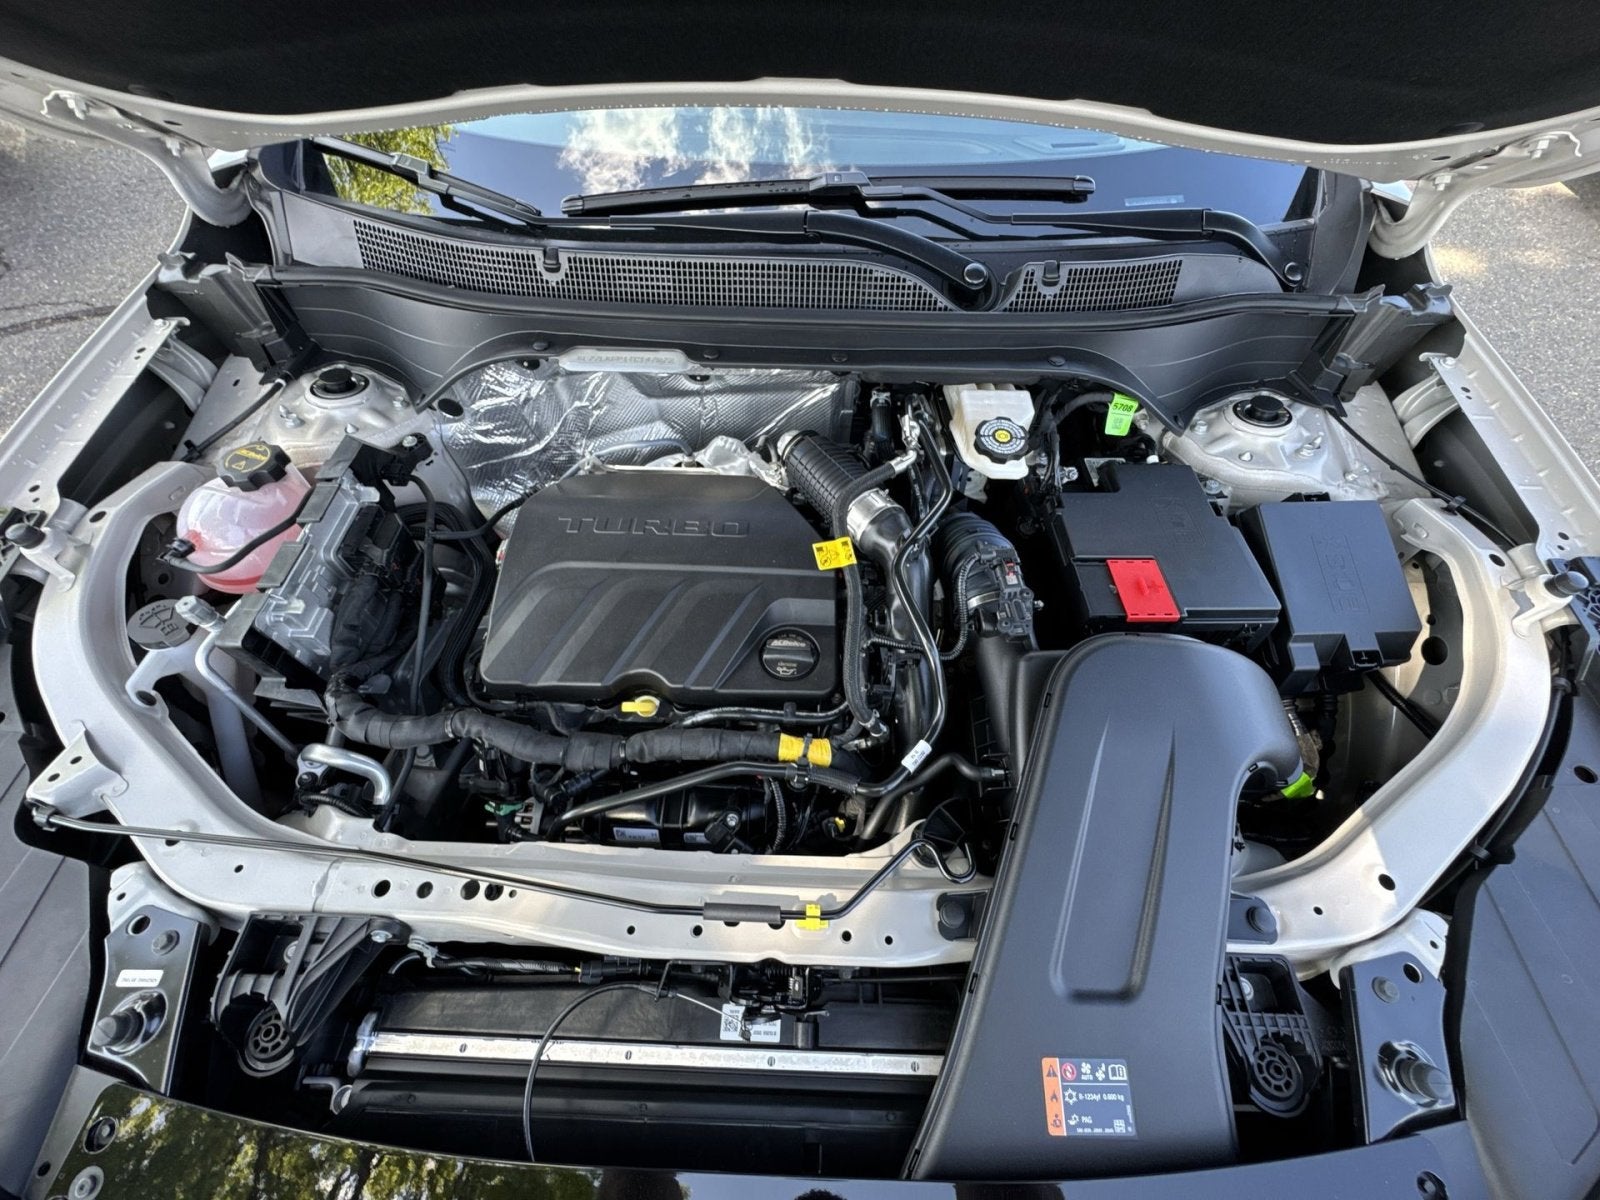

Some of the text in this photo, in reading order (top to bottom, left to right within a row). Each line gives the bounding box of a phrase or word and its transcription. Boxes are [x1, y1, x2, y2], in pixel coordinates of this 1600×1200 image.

[1112, 402, 1133, 412] 5708
[558, 516, 749, 538] TURBO
[1081, 1115, 1093, 1124] PAG
